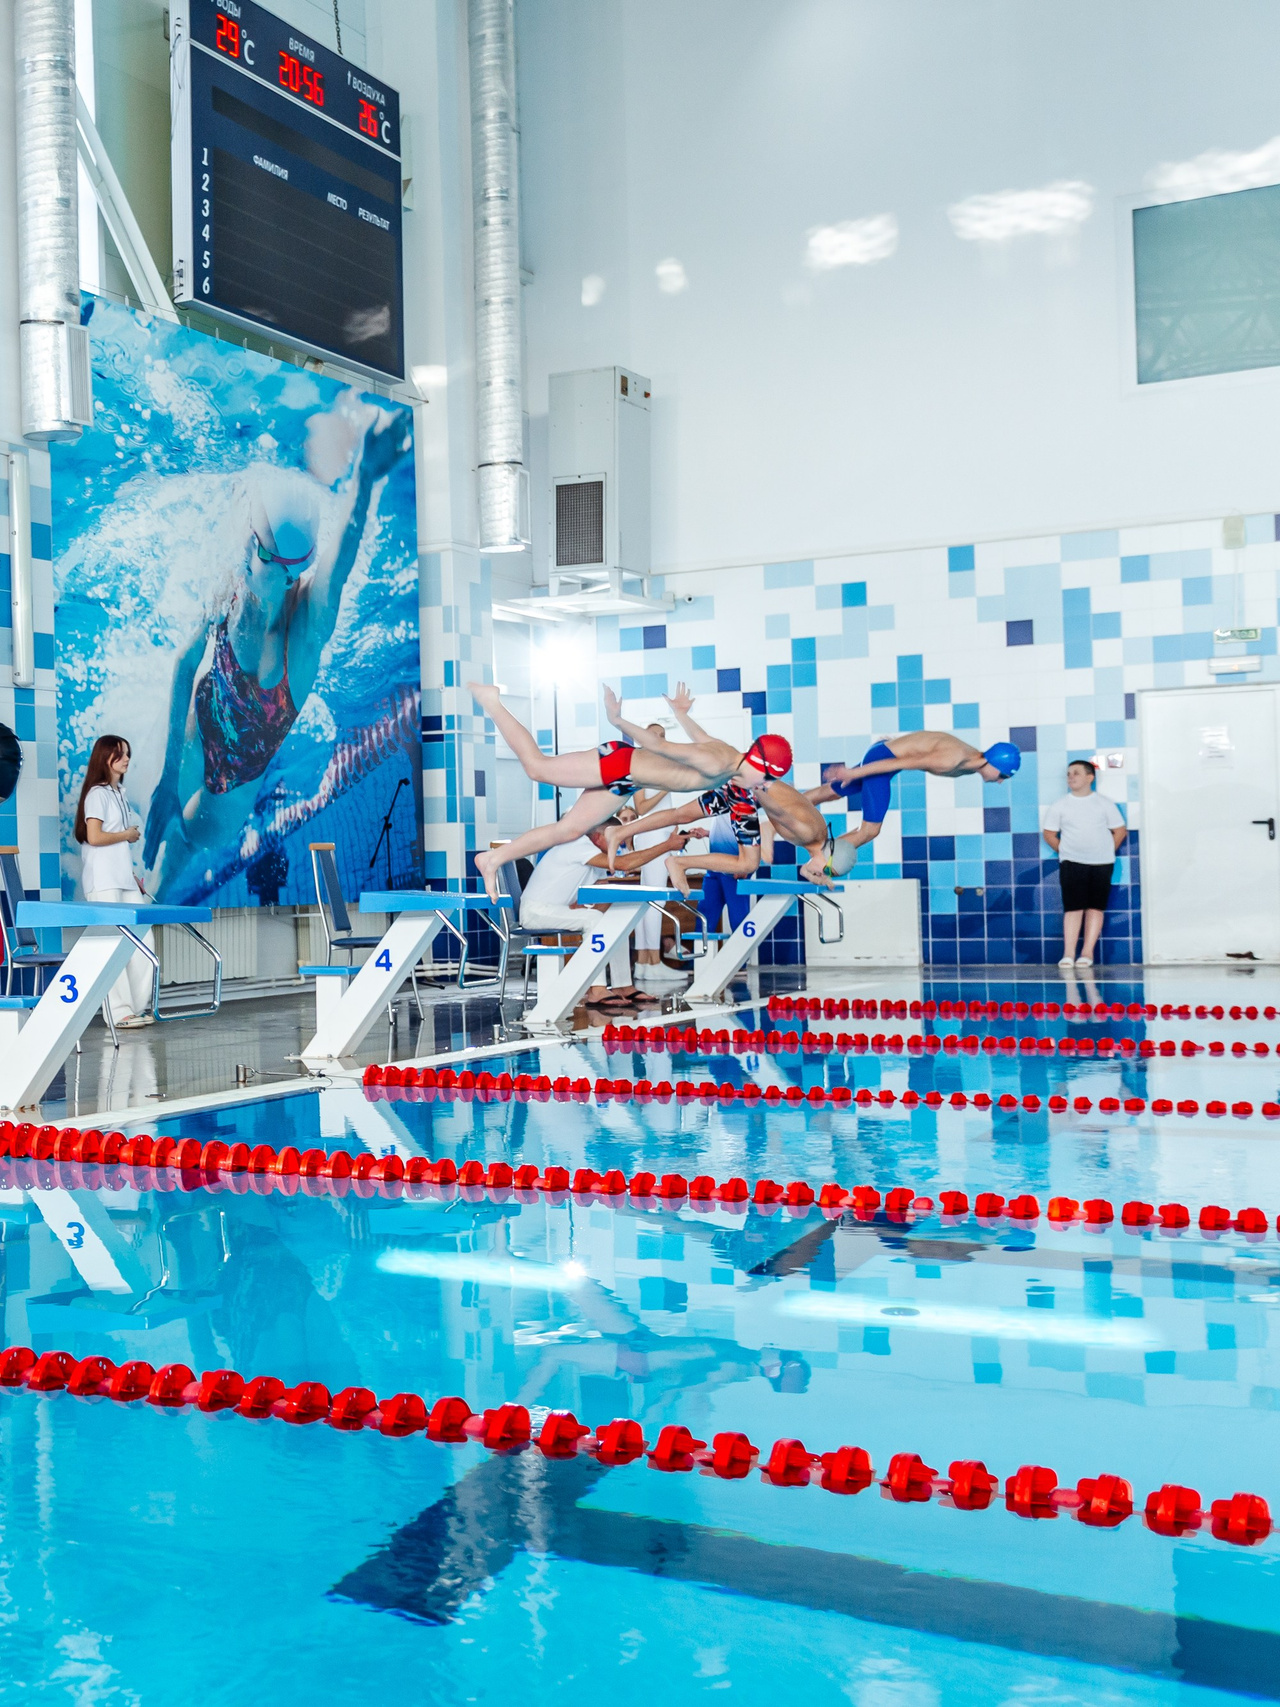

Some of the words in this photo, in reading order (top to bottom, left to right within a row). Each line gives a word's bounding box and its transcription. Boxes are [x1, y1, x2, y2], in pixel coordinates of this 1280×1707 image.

[216, 13, 239, 58] 29
[288, 37, 315, 63] ВРЕМЯ
[352, 76, 386, 107] ВОЗДУХА
[358, 99, 378, 138] 26
[202, 147, 209, 166] 1
[252, 154, 288, 181] ФАМИЛИЯ
[202, 173, 209, 192] 2
[202, 199, 210, 217] 3
[326, 192, 348, 211] МЕСТО
[202, 224, 210, 242] 4
[202, 250, 210, 269] 5
[202, 276, 210, 294] 6
[742, 920, 756, 938] 6
[591, 933, 606, 953] 5
[375, 948, 393, 972] 4
[59, 974, 79, 1004] 3
